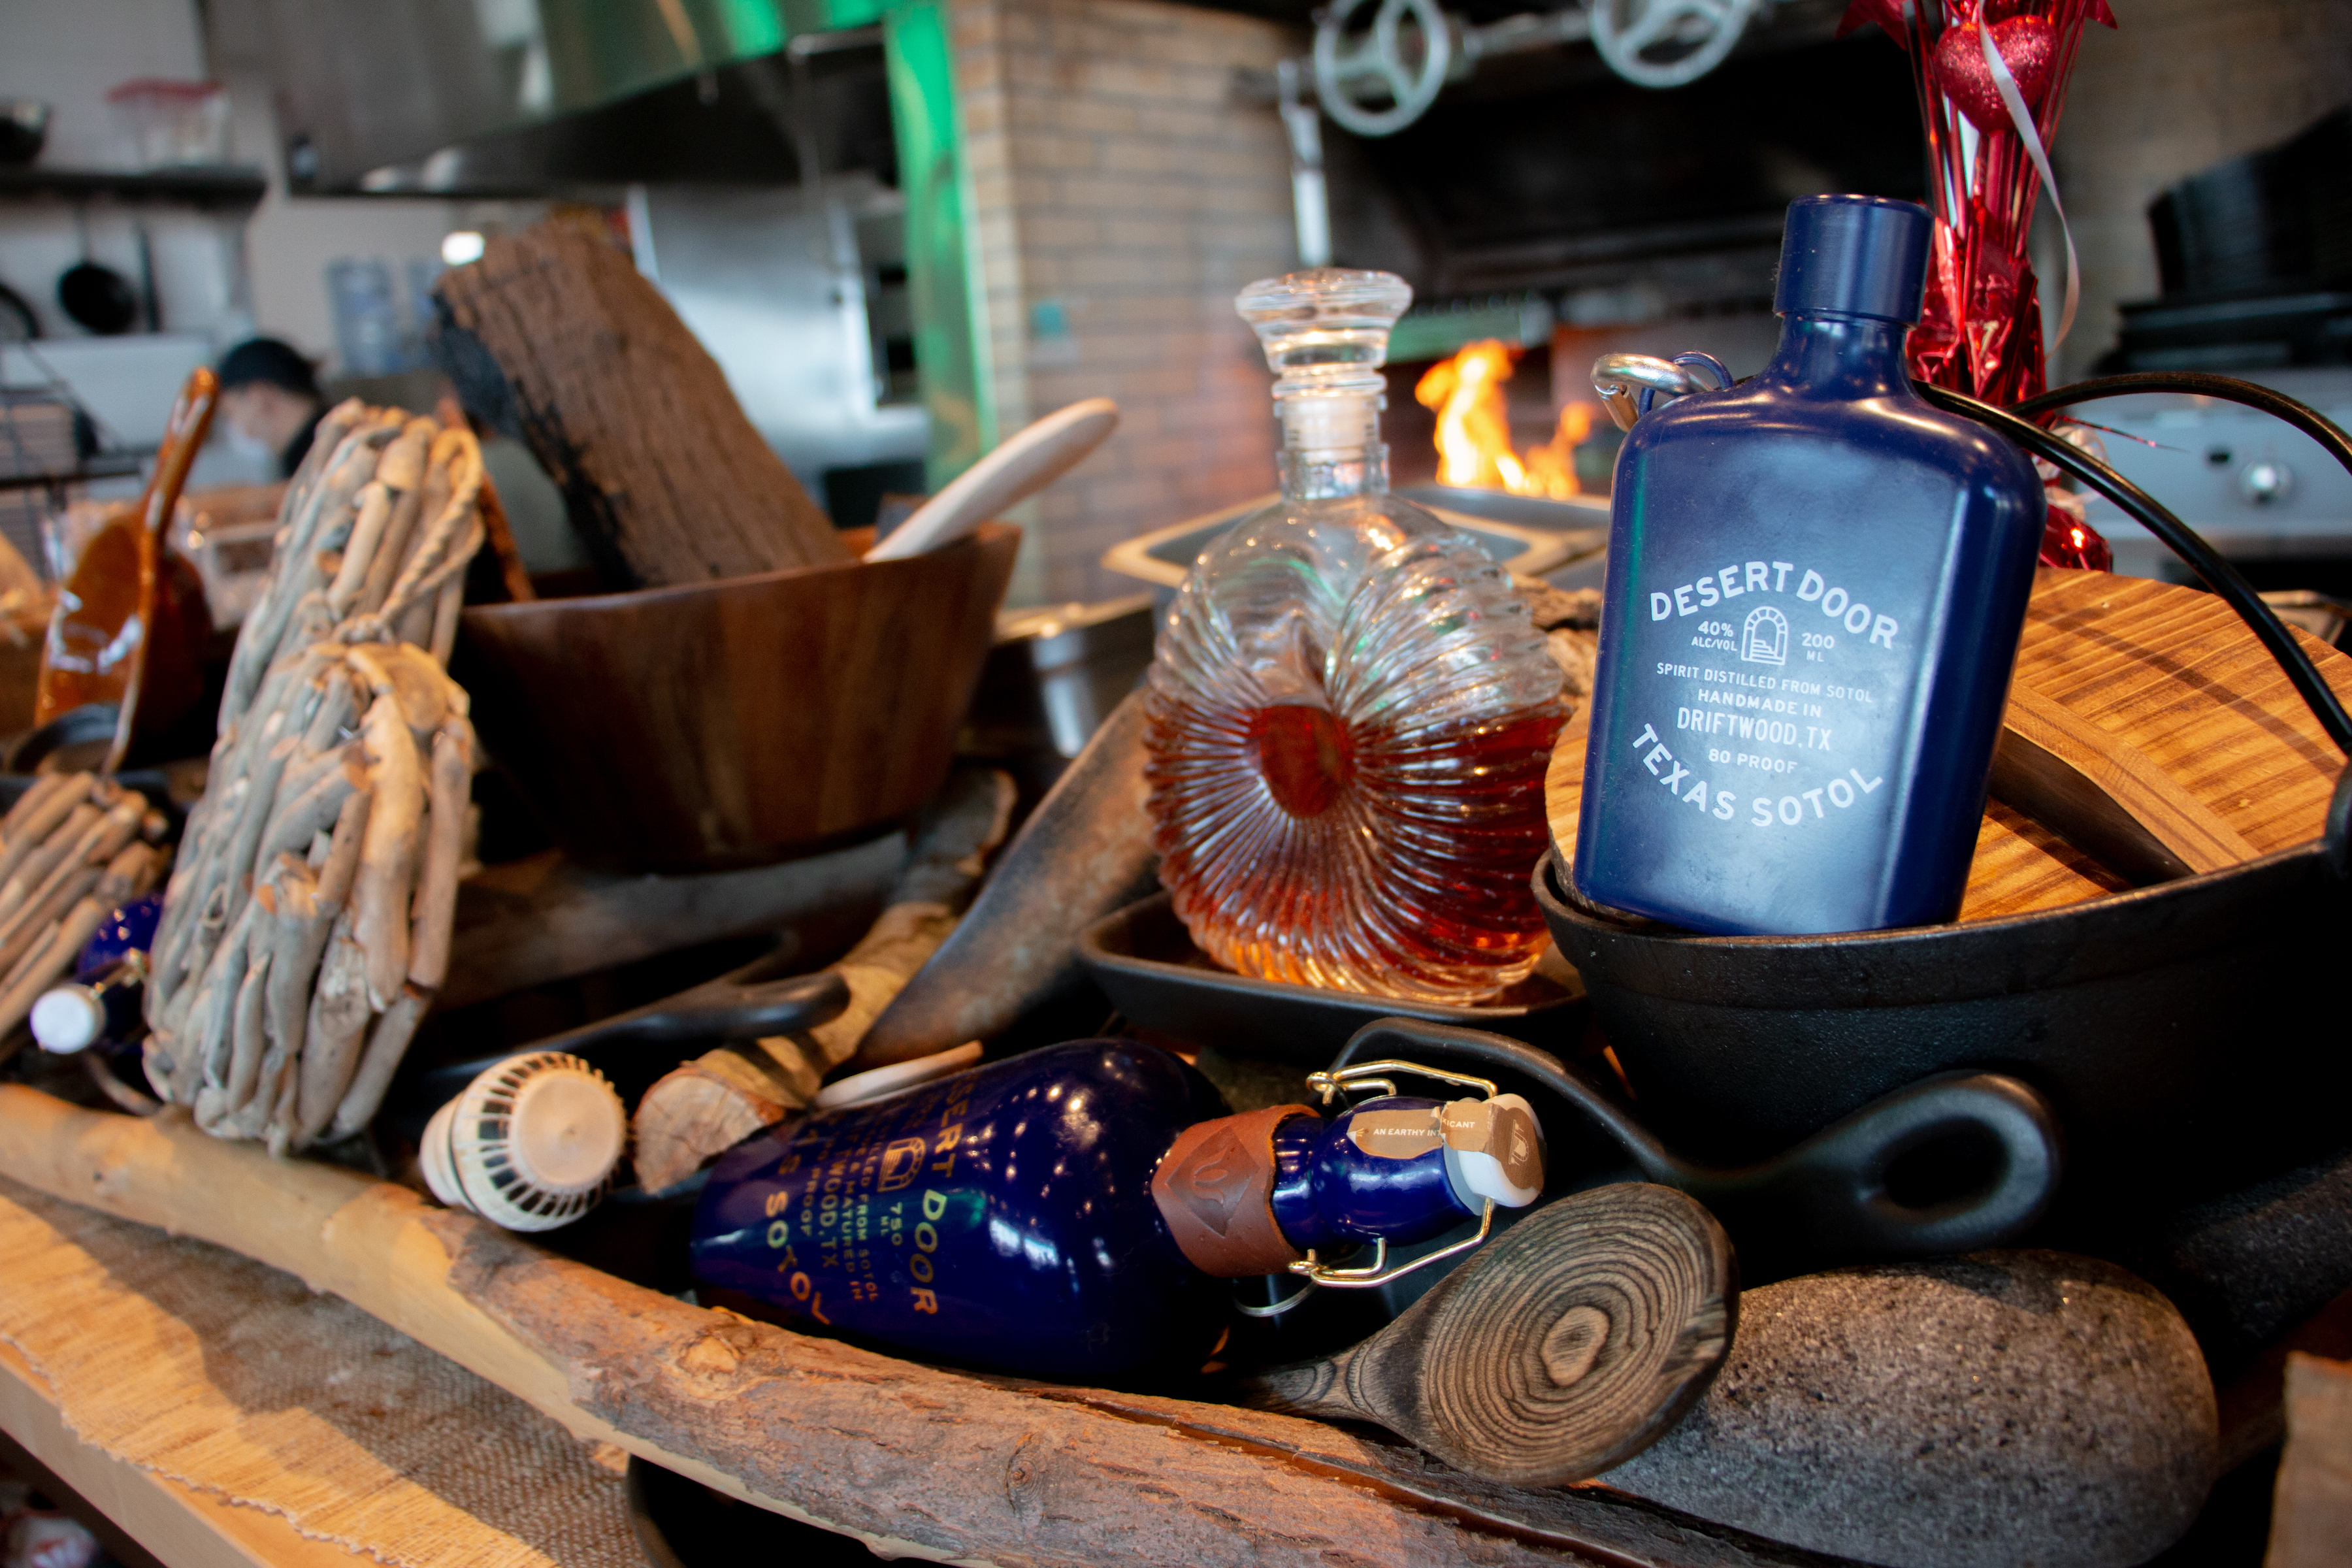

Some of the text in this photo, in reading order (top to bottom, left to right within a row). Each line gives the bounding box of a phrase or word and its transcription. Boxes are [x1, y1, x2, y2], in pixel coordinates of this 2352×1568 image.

[1651, 561, 1898, 649] DESERT DOOR
[1691, 636, 1738, 652] ALC/VOL
[1698, 621, 1734, 638] 40%
[1802, 633, 1835, 649] 200
[1806, 651, 1824, 662] ML
[1656, 662, 1872, 703] SPIRIT DISTILLED FROM SOTOL
[1698, 689, 1821, 717] HANDMADE IN
[1633, 723, 1882, 827] TEXAS SOTOL
[1708, 749, 1797, 774] 80 PROOF
[910, 1074, 979, 1315] SERT DOOR
[855, 1193, 870, 1241] FROM
[889, 1201, 903, 1247] 750
[765, 1190, 832, 1326] SOTOL
[858, 1249, 879, 1302] SOTOL
[849, 1280, 864, 1300] IN
